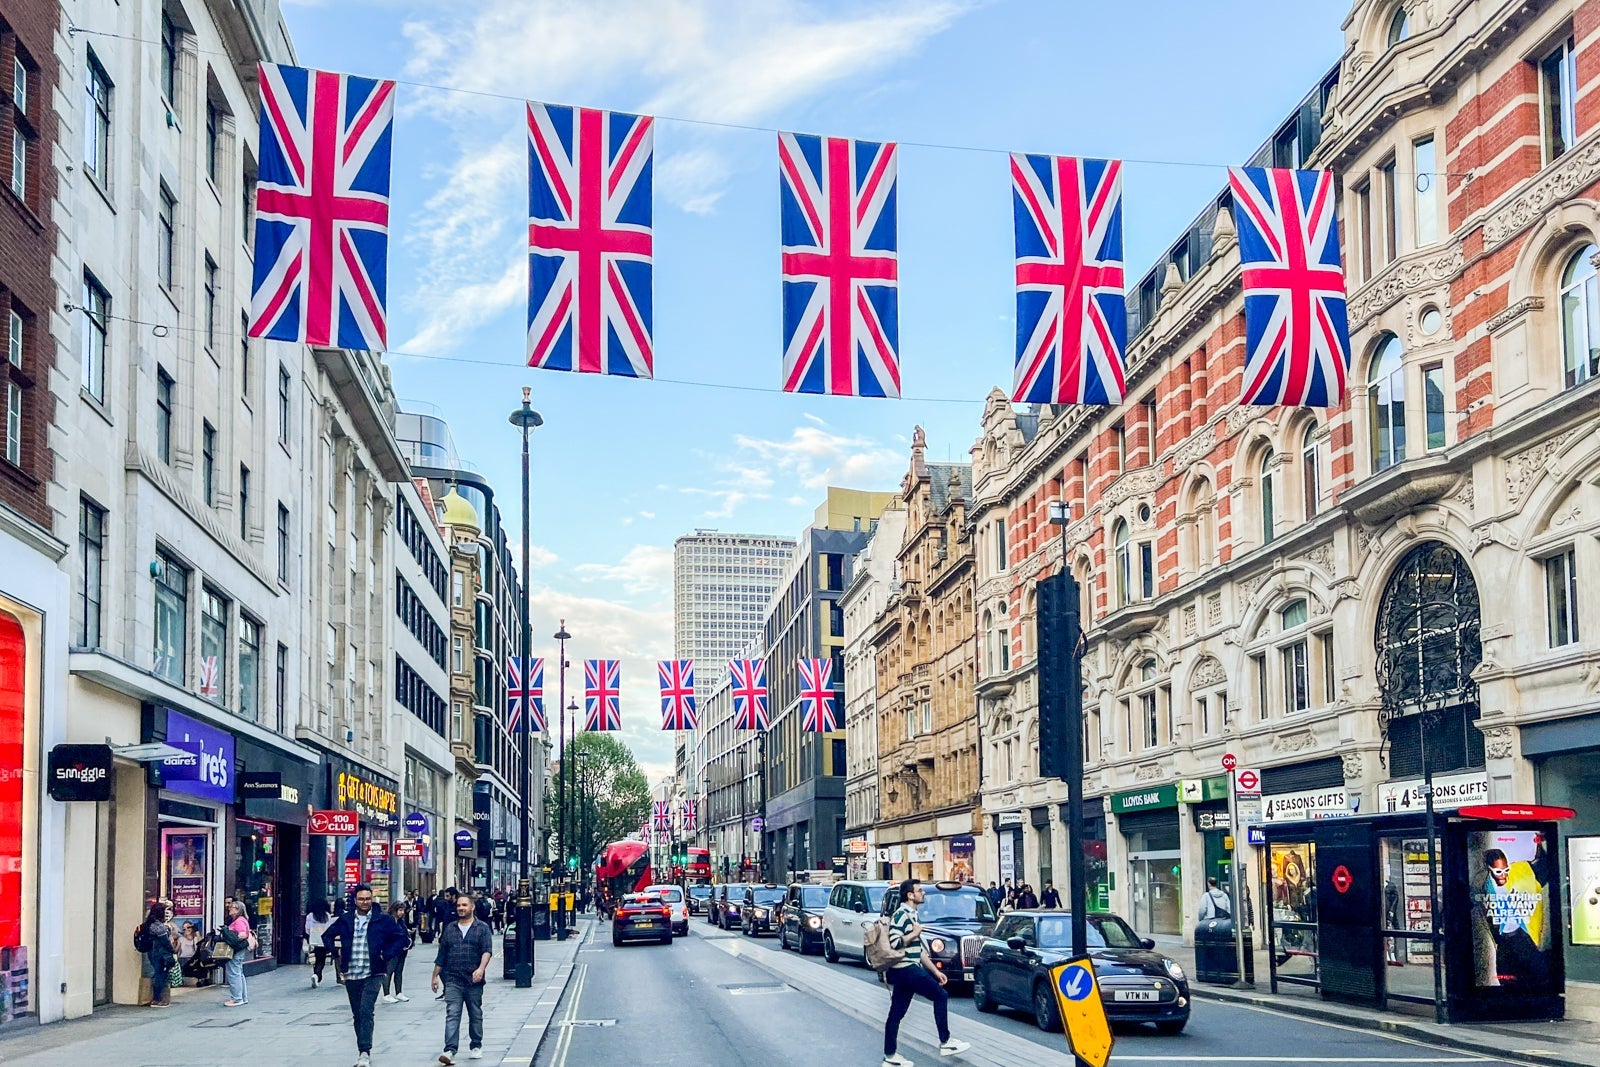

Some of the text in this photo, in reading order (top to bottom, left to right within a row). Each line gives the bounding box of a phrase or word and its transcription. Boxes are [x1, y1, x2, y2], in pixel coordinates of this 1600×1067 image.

[164, 757, 197, 766] claire's
[56, 766, 106, 782] smiggle
[1122, 792, 1160, 808] LLOYDS BANK
[1400, 788, 1410, 808] 4
[1459, 781, 1488, 795] GIFTS
[1265, 800, 1274, 820] 4
[1276, 796, 1315, 812] SEASONS
[1318, 792, 1344, 807] GIFTS
[1474, 894, 1543, 902] EVERYTHING
[1486, 908, 1536, 916] ALREADY
[1492, 917, 1530, 925] EXISTS
